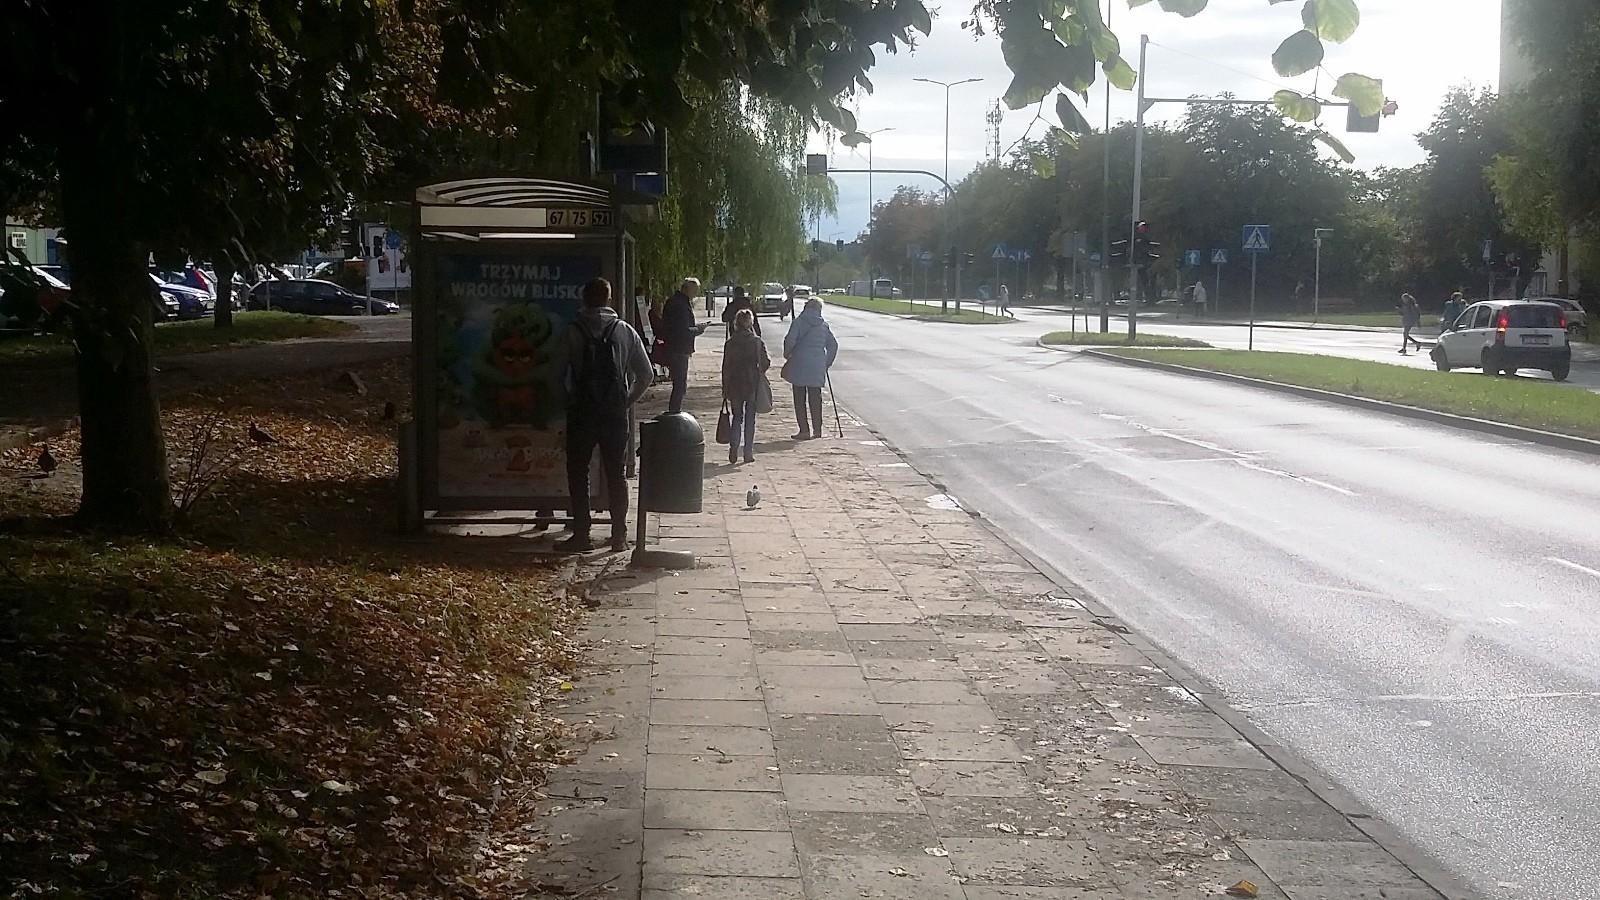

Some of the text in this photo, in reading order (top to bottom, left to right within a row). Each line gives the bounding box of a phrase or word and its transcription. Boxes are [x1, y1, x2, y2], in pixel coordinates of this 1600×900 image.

[550, 211, 564, 225] 67
[572, 211, 586, 225] 75
[480, 264, 561, 281] TRZYMAJ
[450, 280, 528, 298] WROGÓW
